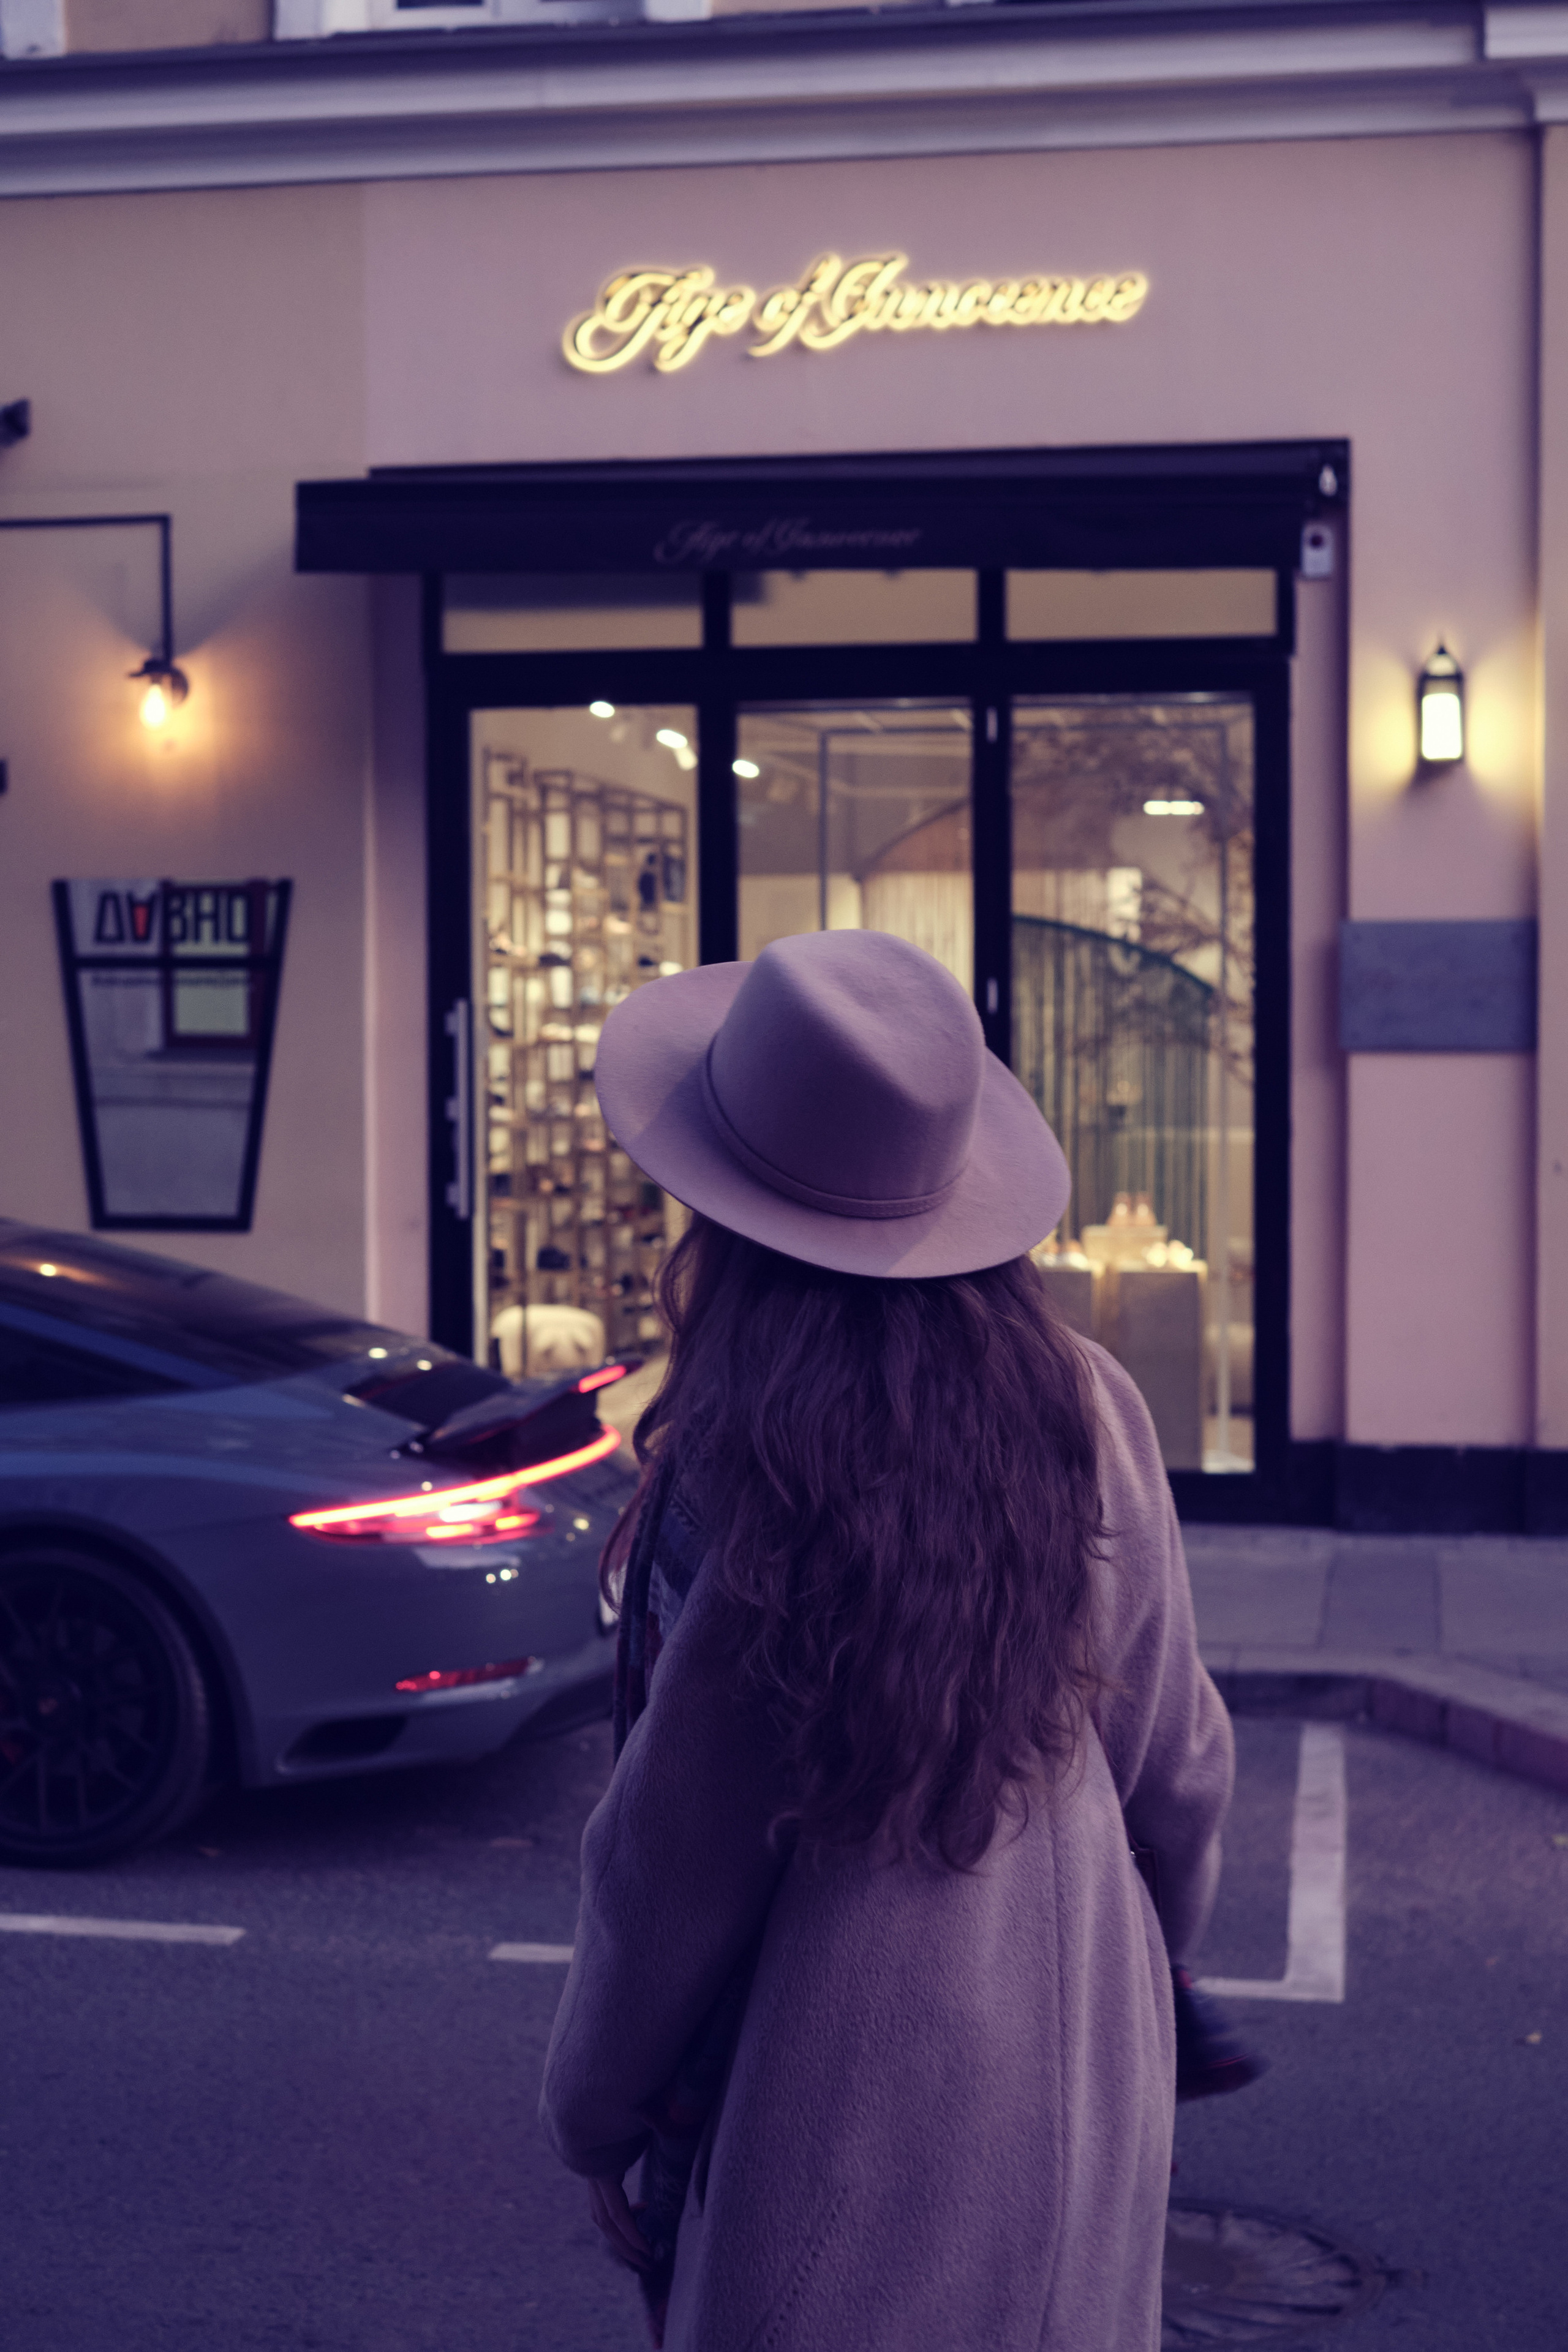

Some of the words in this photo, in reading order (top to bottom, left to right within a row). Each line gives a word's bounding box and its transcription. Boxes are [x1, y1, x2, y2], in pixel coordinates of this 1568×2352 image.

[562, 265, 757, 372] Age
[748, 252, 843, 357] of
[799, 251, 1149, 349] Innocence
